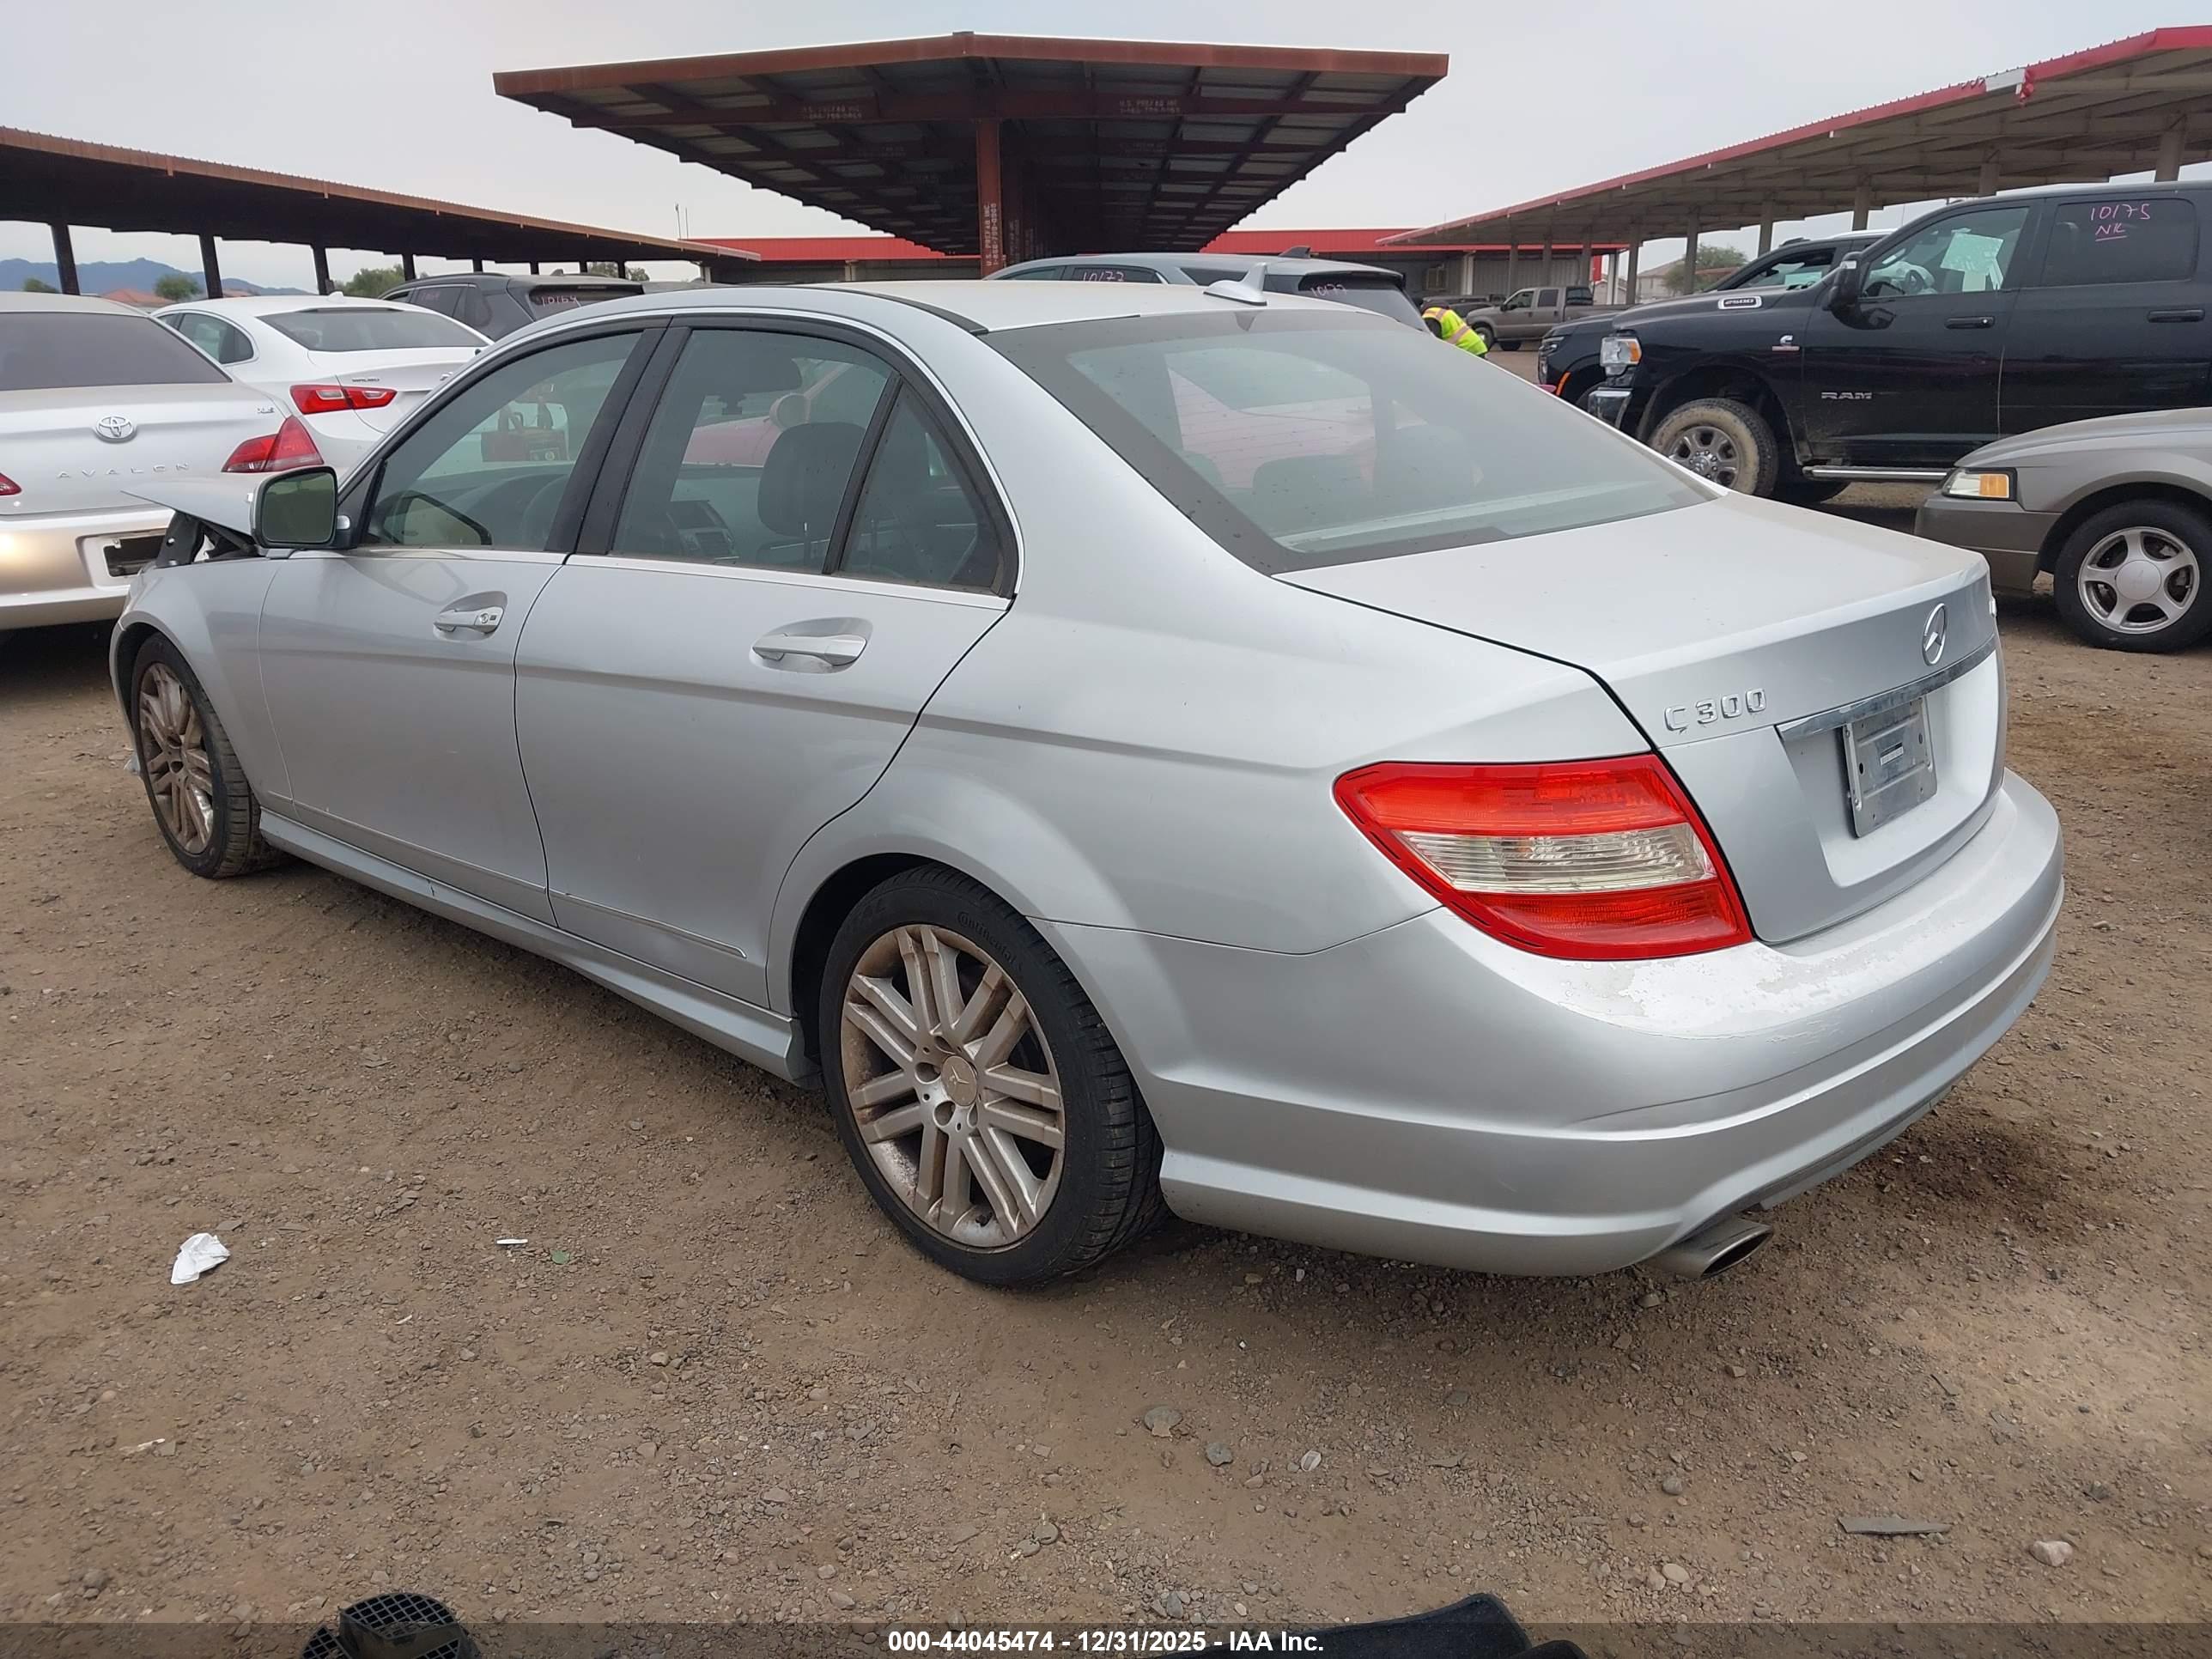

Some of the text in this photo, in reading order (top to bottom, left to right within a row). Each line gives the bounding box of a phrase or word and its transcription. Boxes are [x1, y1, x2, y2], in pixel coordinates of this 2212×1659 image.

[2090, 203, 2151, 221] 10175
[57, 462, 190, 478] AVALON
[1664, 688, 1767, 732] C 300
